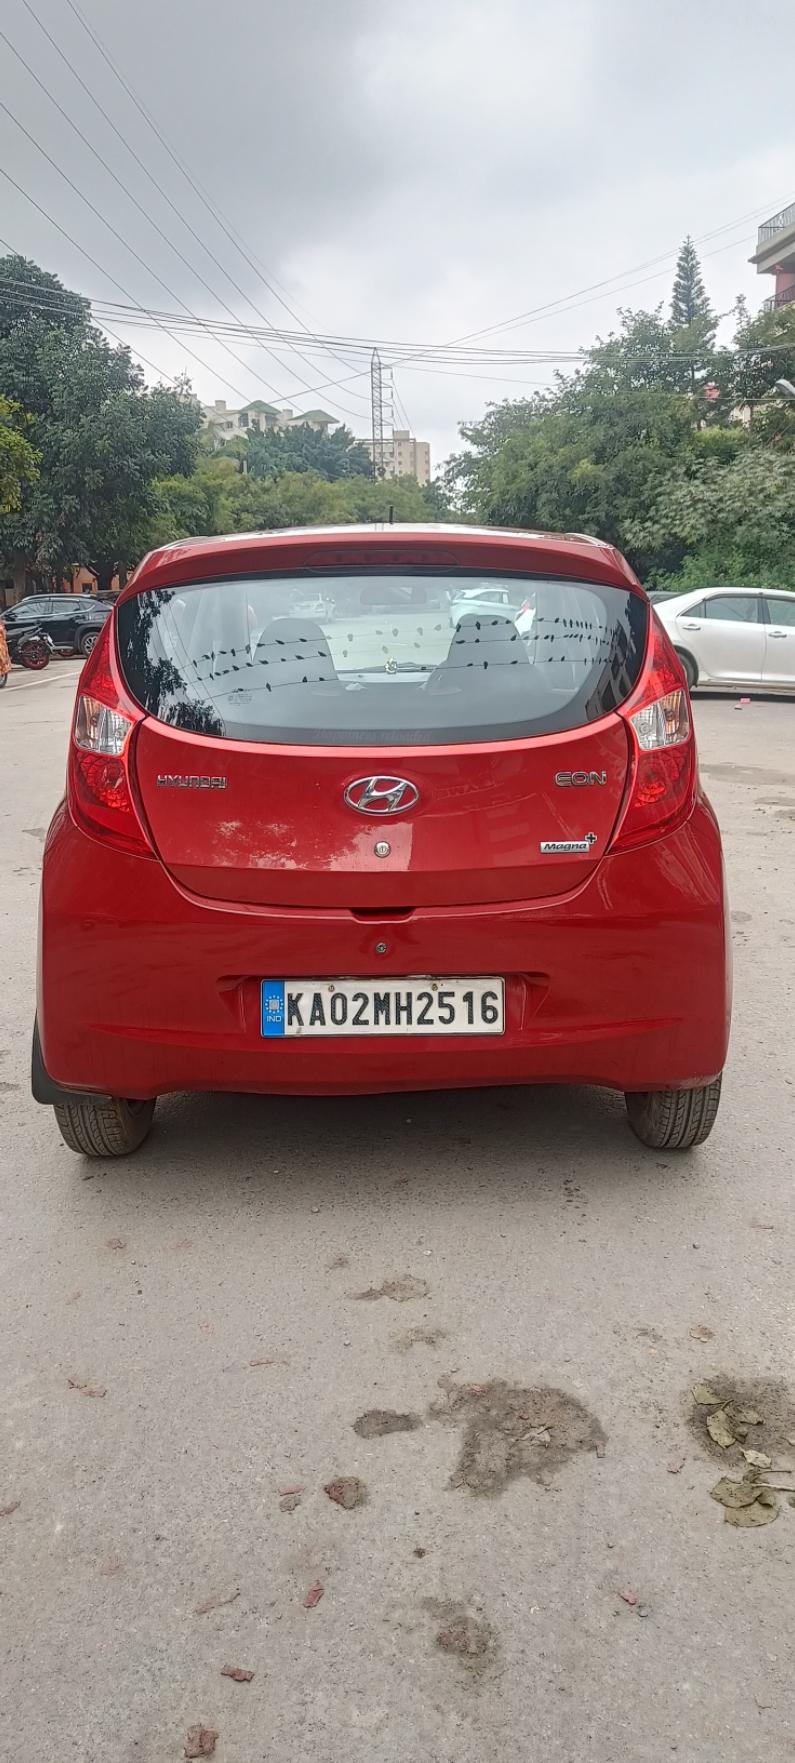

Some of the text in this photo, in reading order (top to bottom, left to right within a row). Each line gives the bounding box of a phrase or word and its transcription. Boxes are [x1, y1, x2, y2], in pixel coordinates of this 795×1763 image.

[157, 774, 227, 789] HYUNDAI
[555, 770, 607, 786] EON
[287, 991, 499, 1026] KA02MH2516
[266, 1015, 282, 1023] IND
